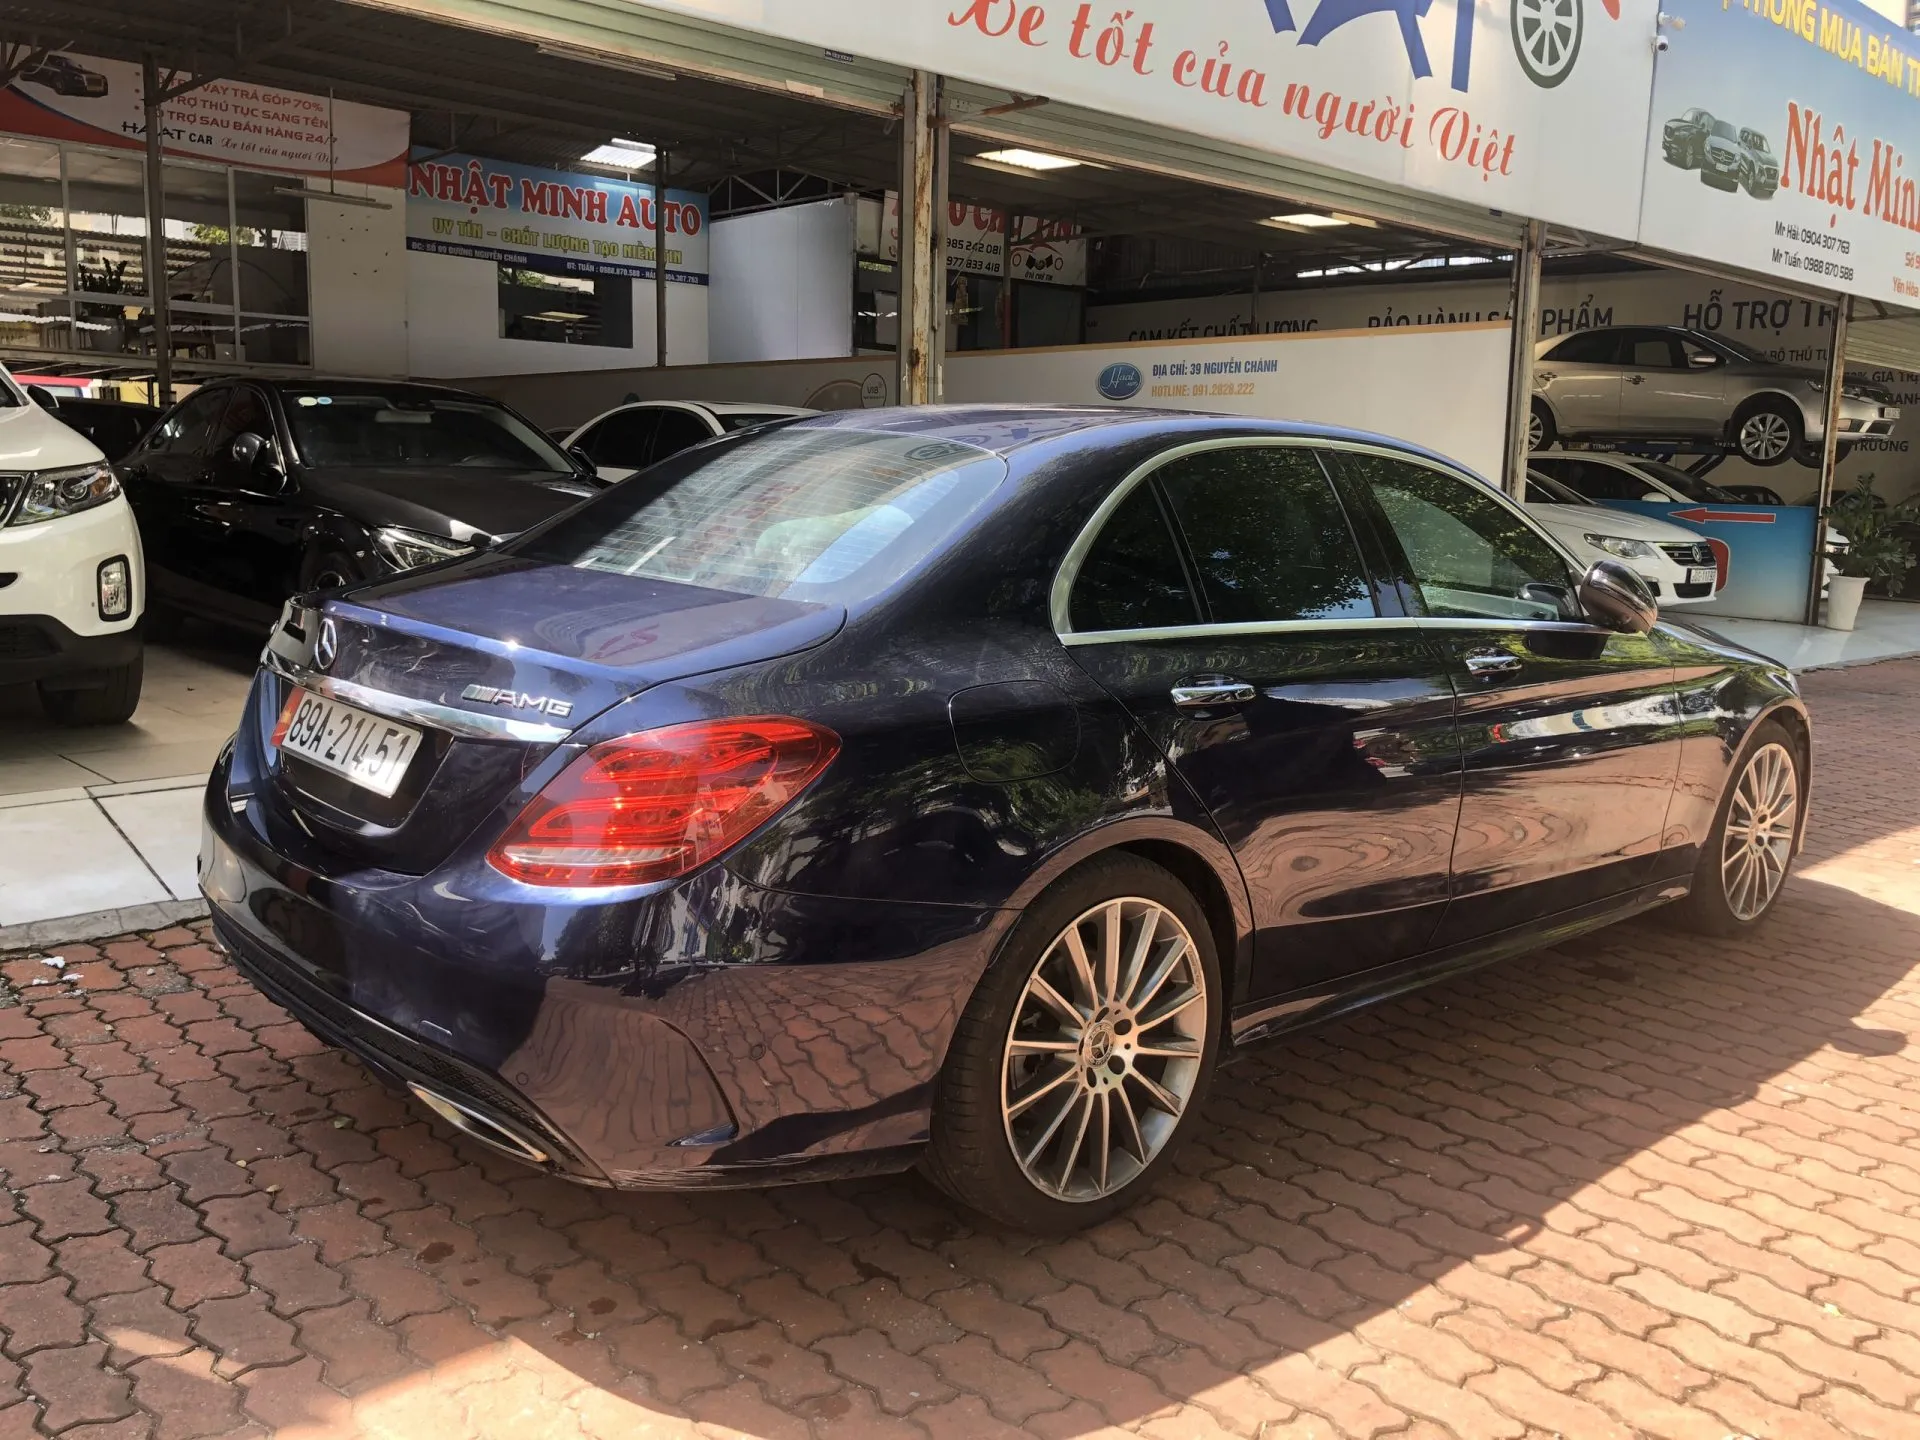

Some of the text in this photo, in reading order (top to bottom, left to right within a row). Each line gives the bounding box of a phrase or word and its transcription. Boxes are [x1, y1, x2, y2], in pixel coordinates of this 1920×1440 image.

[1819, 7, 1864, 69] MUA
[1866, 33, 1905, 89] BÁN
[202, 84, 229, 95] VAY
[262, 94, 291, 106] GÓP
[292, 98, 323, 112] 70%
[1068, 3, 1154, 76] tốt
[1172, 42, 1268, 108] của
[1282, 86, 1415, 140] người
[1430, 106, 1517, 183] Việt
[167, 110, 197, 125] TRỢ
[200, 116, 229, 129] SAU
[233, 121, 263, 134] BÁN
[265, 126, 303, 141] HÀNG
[261, 110, 301, 125] SANG
[302, 115, 329, 130] TÊN
[188, 132, 213, 145] CAR
[1780, 100, 1920, 233] Nhật Min
[410, 160, 702, 237] NHẬT MINH AUTO
[432, 217, 454, 235] UY
[501, 226, 540, 247] CHẤT
[542, 231, 590, 254] LƯỢNG
[593, 239, 619, 259] TẠO
[965, 241, 984, 254] 242
[1774, 220, 1786, 236] Mr
[1800, 228, 1821, 246] 0904
[1822, 234, 1836, 250] 307
[1836, 239, 1851, 255] 763
[965, 258, 984, 271] 833
[985, 261, 1000, 274] 418
[1771, 247, 1783, 264] Mr
[1803, 256, 1823, 274] 0988
[1824, 262, 1839, 278] 870
[1839, 266, 1854, 282] 588
[1541, 294, 1614, 335] PHẨM
[1683, 289, 1723, 331] HỖ
[1732, 299, 1792, 336] TRỢ
[1152, 364, 1168, 380] ĐỊA
[1189, 362, 1201, 376] 39
[1203, 356, 1242, 375] NGUYỄN
[1243, 356, 1278, 374] CHÁNH
[1151, 382, 1255, 398] HOTLINE: 091.2828.222
[493, 692, 574, 718] AMG
